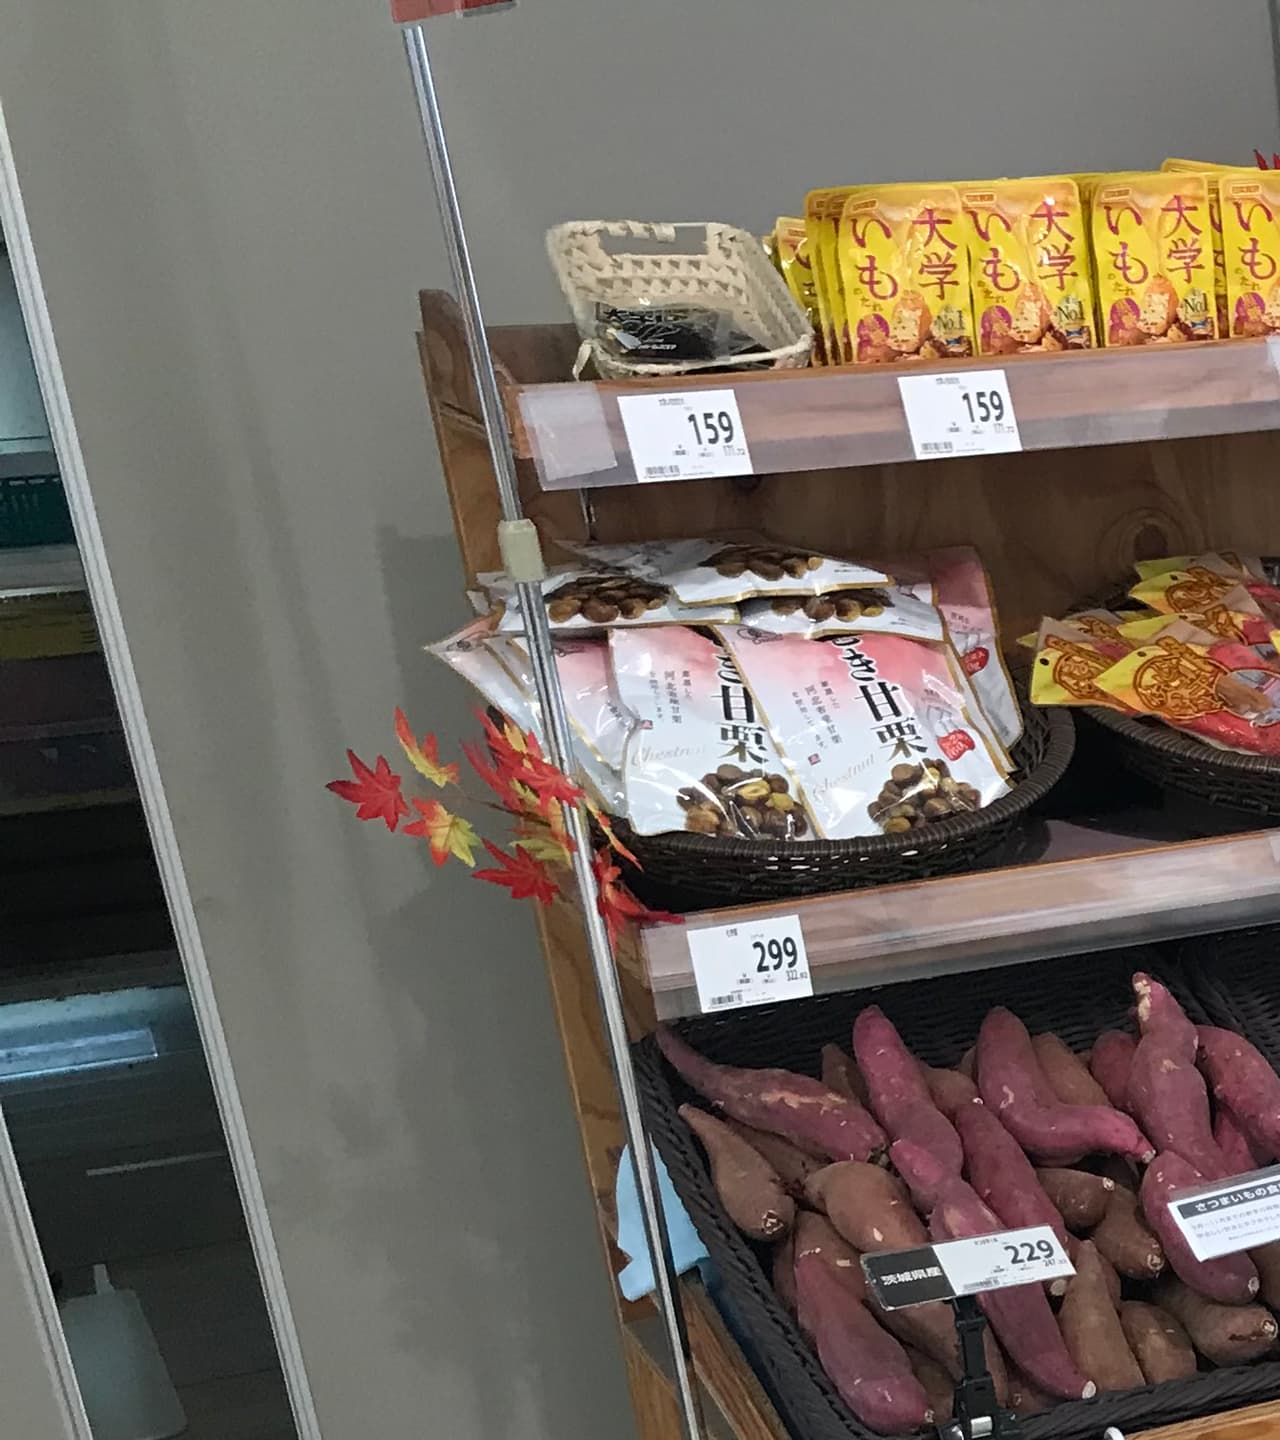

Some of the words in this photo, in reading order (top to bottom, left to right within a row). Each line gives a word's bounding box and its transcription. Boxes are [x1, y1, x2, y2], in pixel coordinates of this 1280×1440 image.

[851, 218, 898, 299] いも
[912, 207, 959, 300] 大学
[967, 209, 1020, 291] いも
[1029, 201, 1077, 291] 大学
[1104, 205, 1149, 285] いも
[1161, 194, 1205, 284] 大学
[1233, 201, 1277, 280] いも
[687, 411, 733, 445] 159
[962, 390, 1004, 423] 159
[753, 936, 798, 974] 299
[881, 1266, 943, 1285] 茨城県産
[1003, 1239, 1055, 1264] 229
